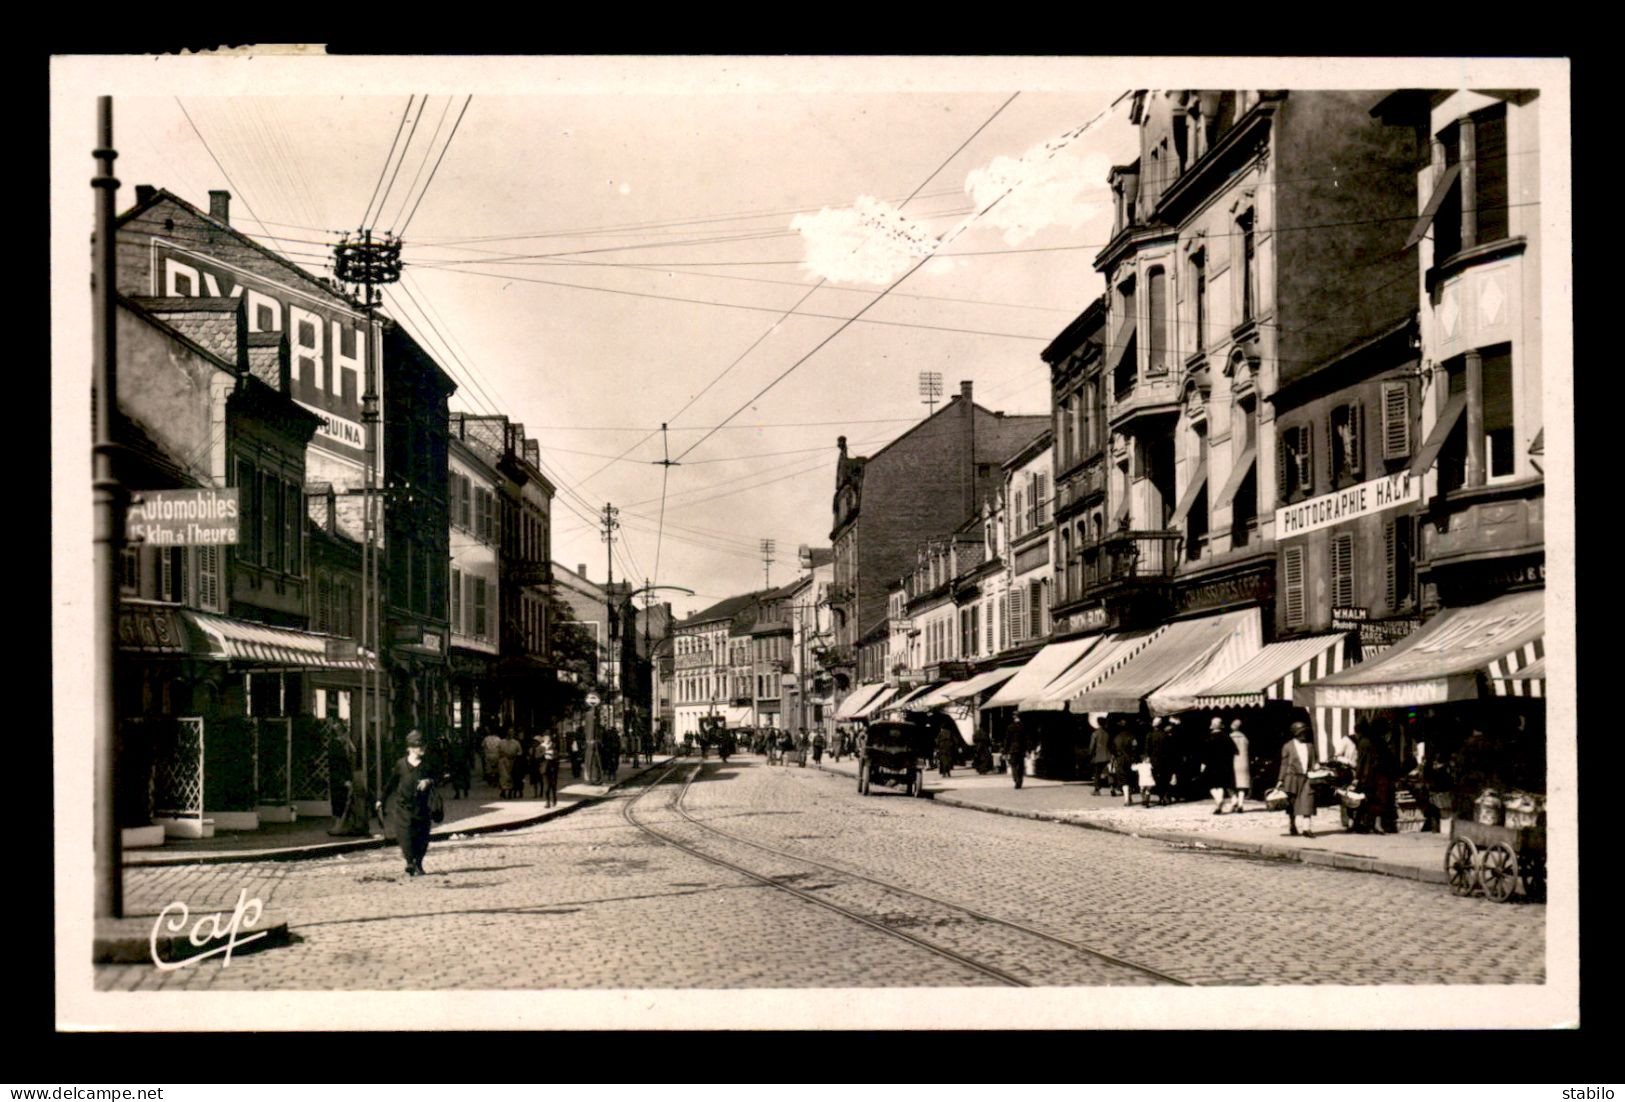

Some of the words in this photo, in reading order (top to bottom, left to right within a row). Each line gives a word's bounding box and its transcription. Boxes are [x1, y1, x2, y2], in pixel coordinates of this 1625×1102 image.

[319, 414, 361, 446] QUINA
[128, 491, 238, 520] Automobiles
[1284, 487, 1366, 532] PHOTOGRAPHIE
[1376, 475, 1411, 507] HALM
[187, 523, 236, 543] l'heure
[1391, 683, 1436, 702] SAVON
